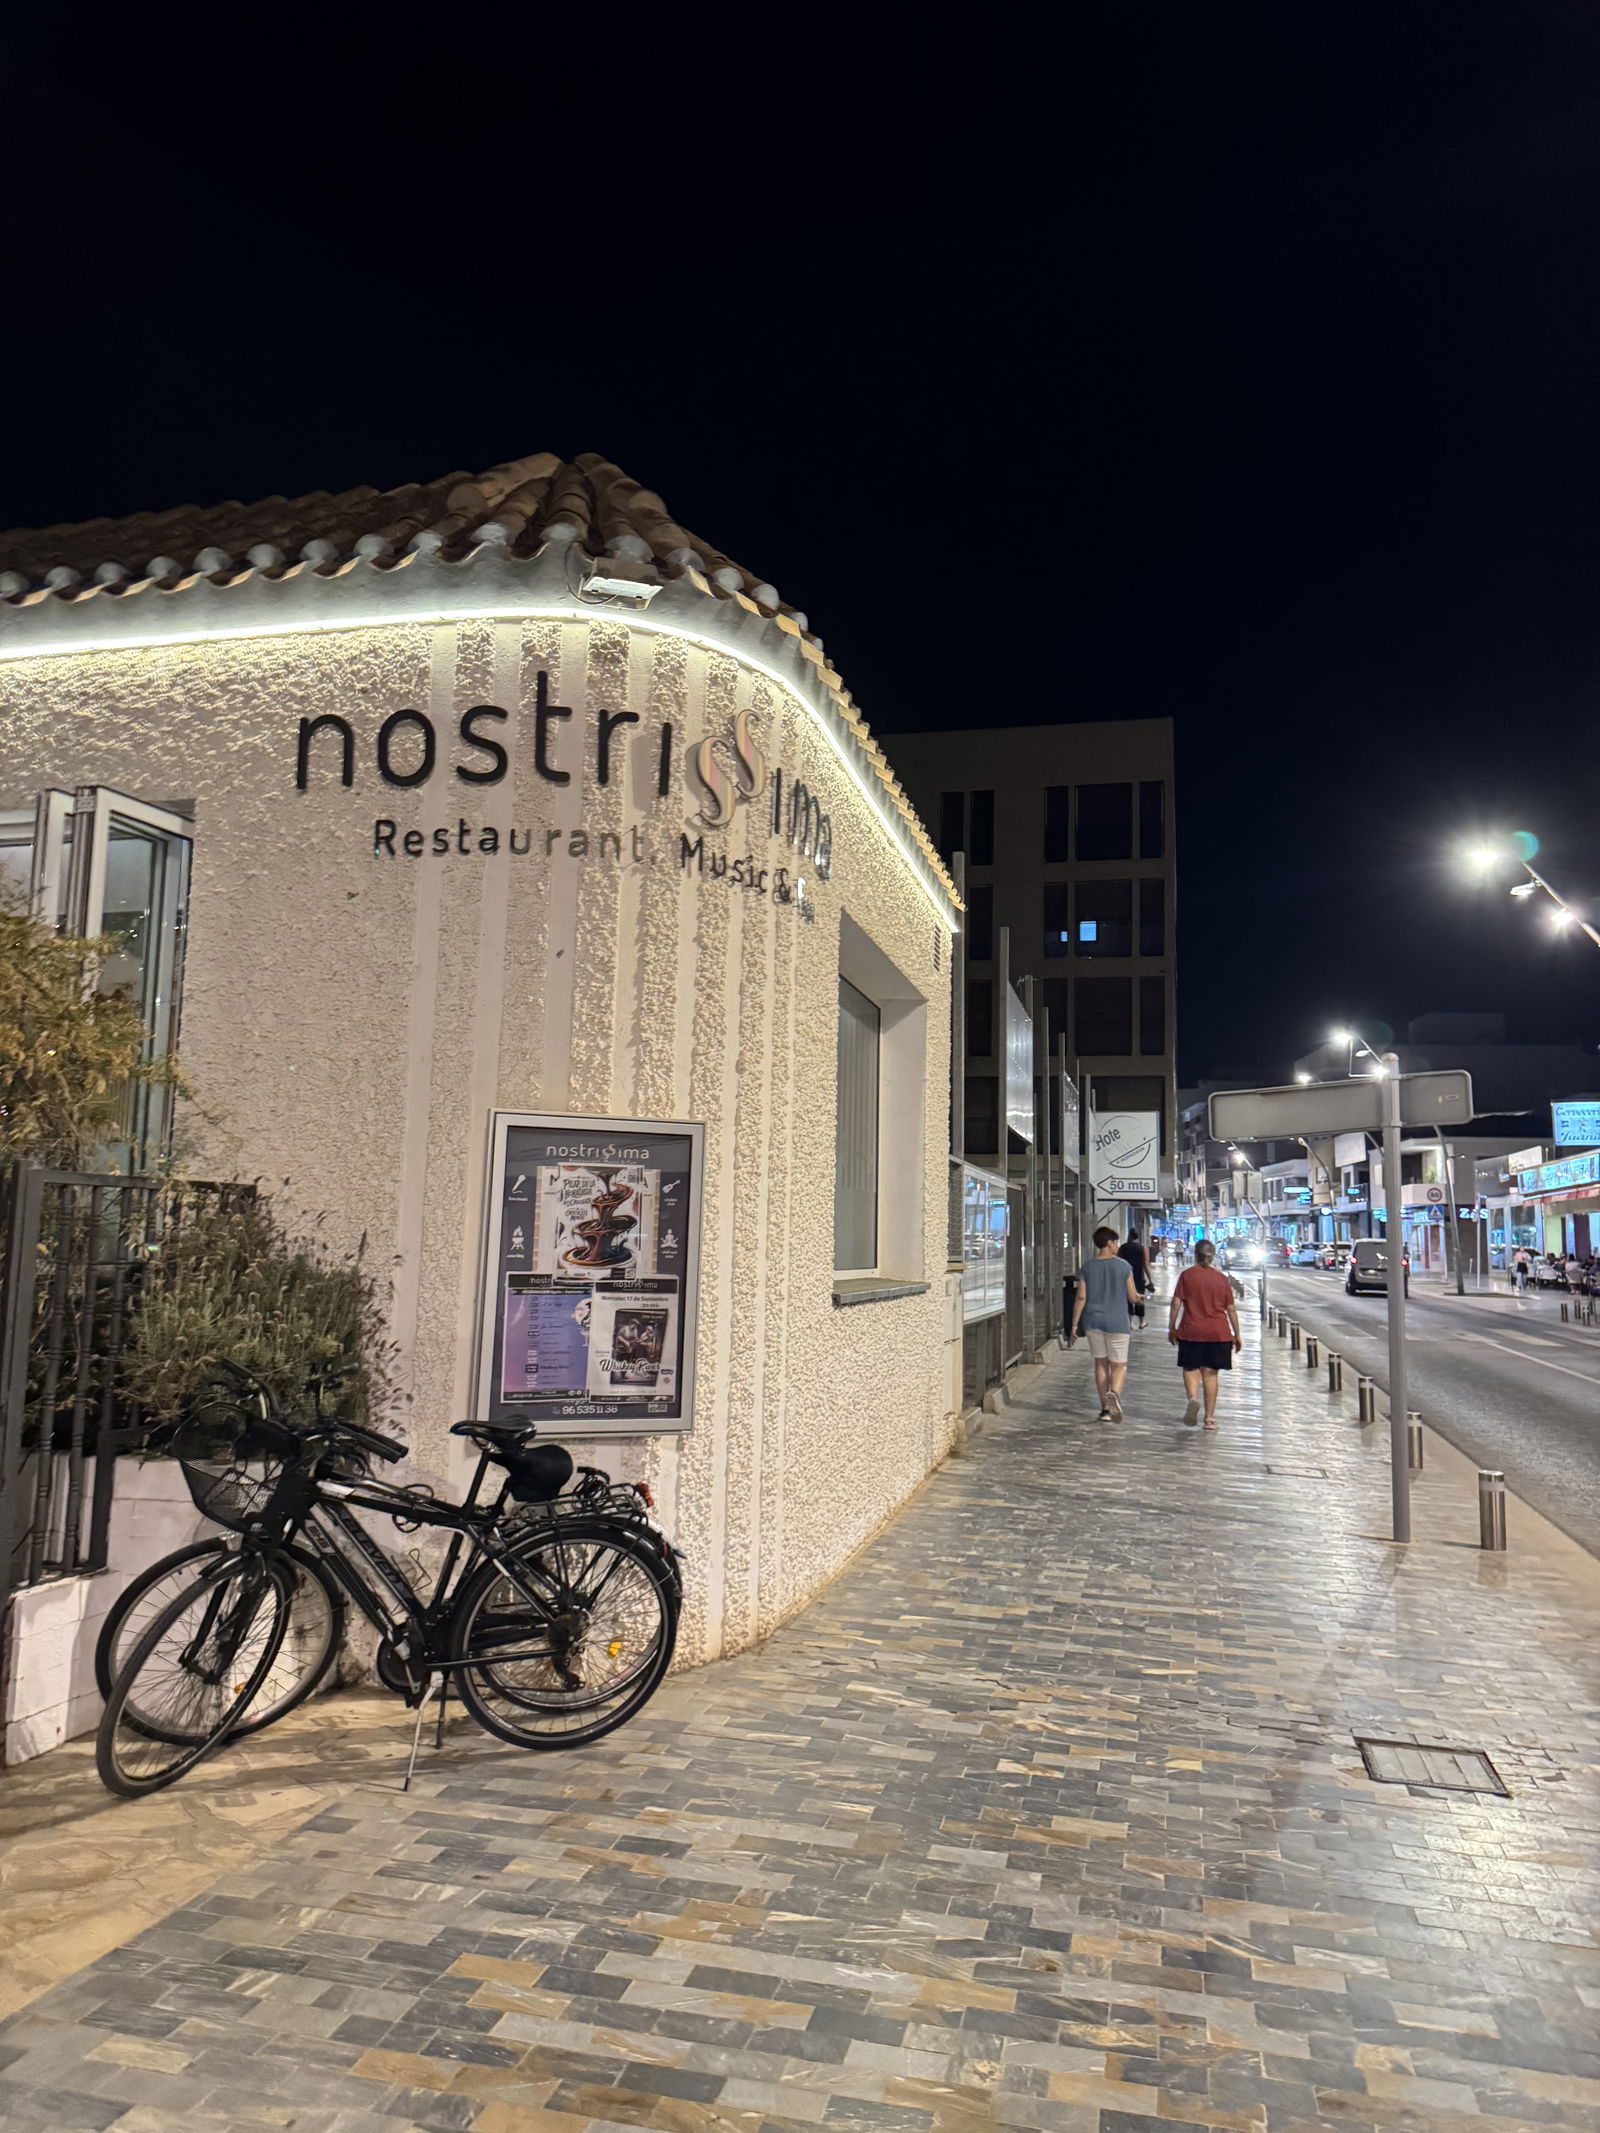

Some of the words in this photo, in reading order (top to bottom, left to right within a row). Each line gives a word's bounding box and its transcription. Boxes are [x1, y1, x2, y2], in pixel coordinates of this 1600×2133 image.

[680, 832, 768, 894] Music
[1110, 1181, 1124, 1190] 50
[1128, 1181, 1150, 1190] mts
[562, 1406, 576, 1414] 96
[577, 1405, 595, 1414] 535
